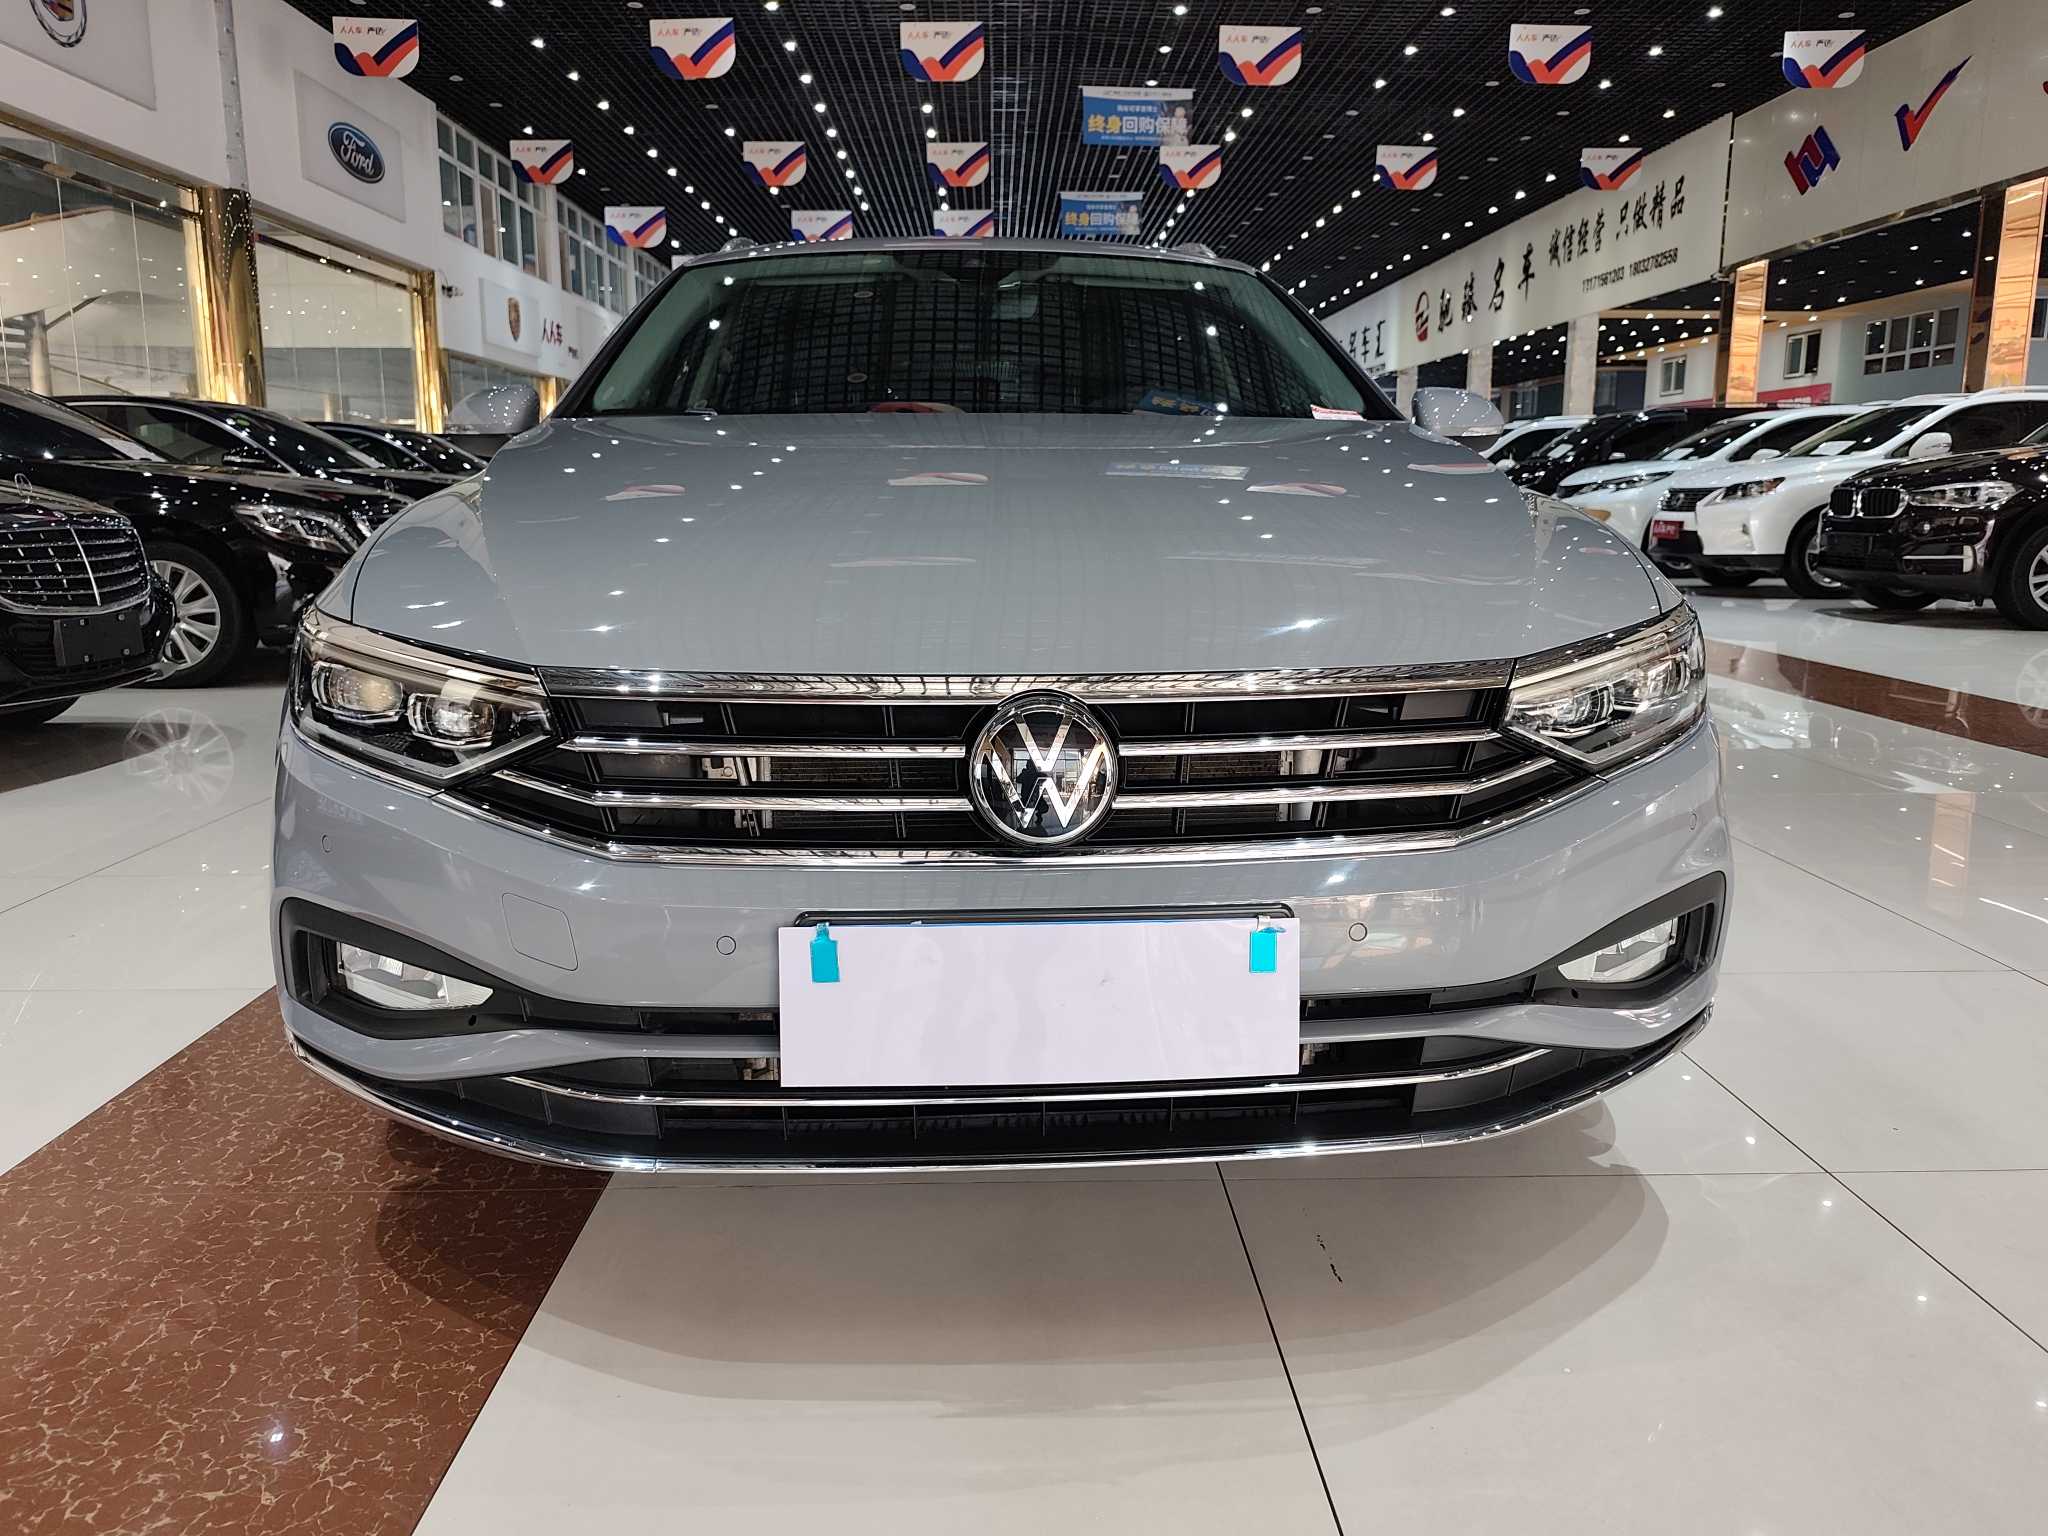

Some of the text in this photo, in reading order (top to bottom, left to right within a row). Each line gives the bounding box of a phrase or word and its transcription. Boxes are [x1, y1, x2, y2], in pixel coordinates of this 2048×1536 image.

[1615, 174, 1686, 241] 只做精品
[542, 317, 563, 346] 人人车
